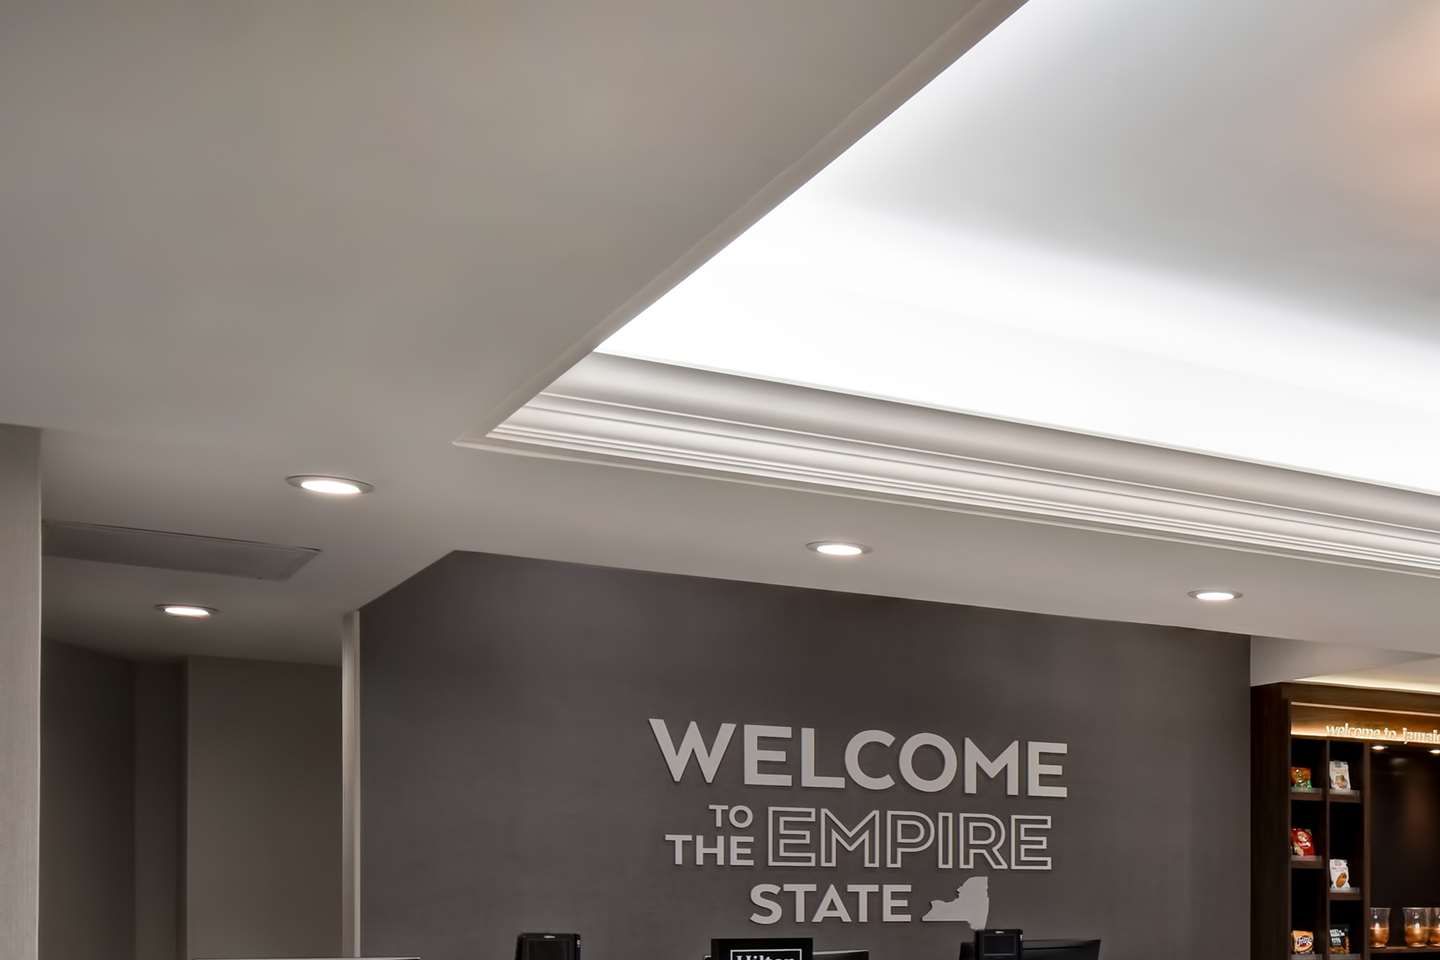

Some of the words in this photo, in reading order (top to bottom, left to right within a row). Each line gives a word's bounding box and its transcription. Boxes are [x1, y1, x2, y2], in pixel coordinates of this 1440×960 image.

[1326, 723, 1380, 738] welcome
[1384, 728, 1396, 738] to
[649, 718, 1068, 797] WELCOME
[709, 804, 753, 828] TO
[665, 834, 754, 866] THE
[768, 806, 1052, 870] EMPIRE
[749, 883, 913, 925] STATE
